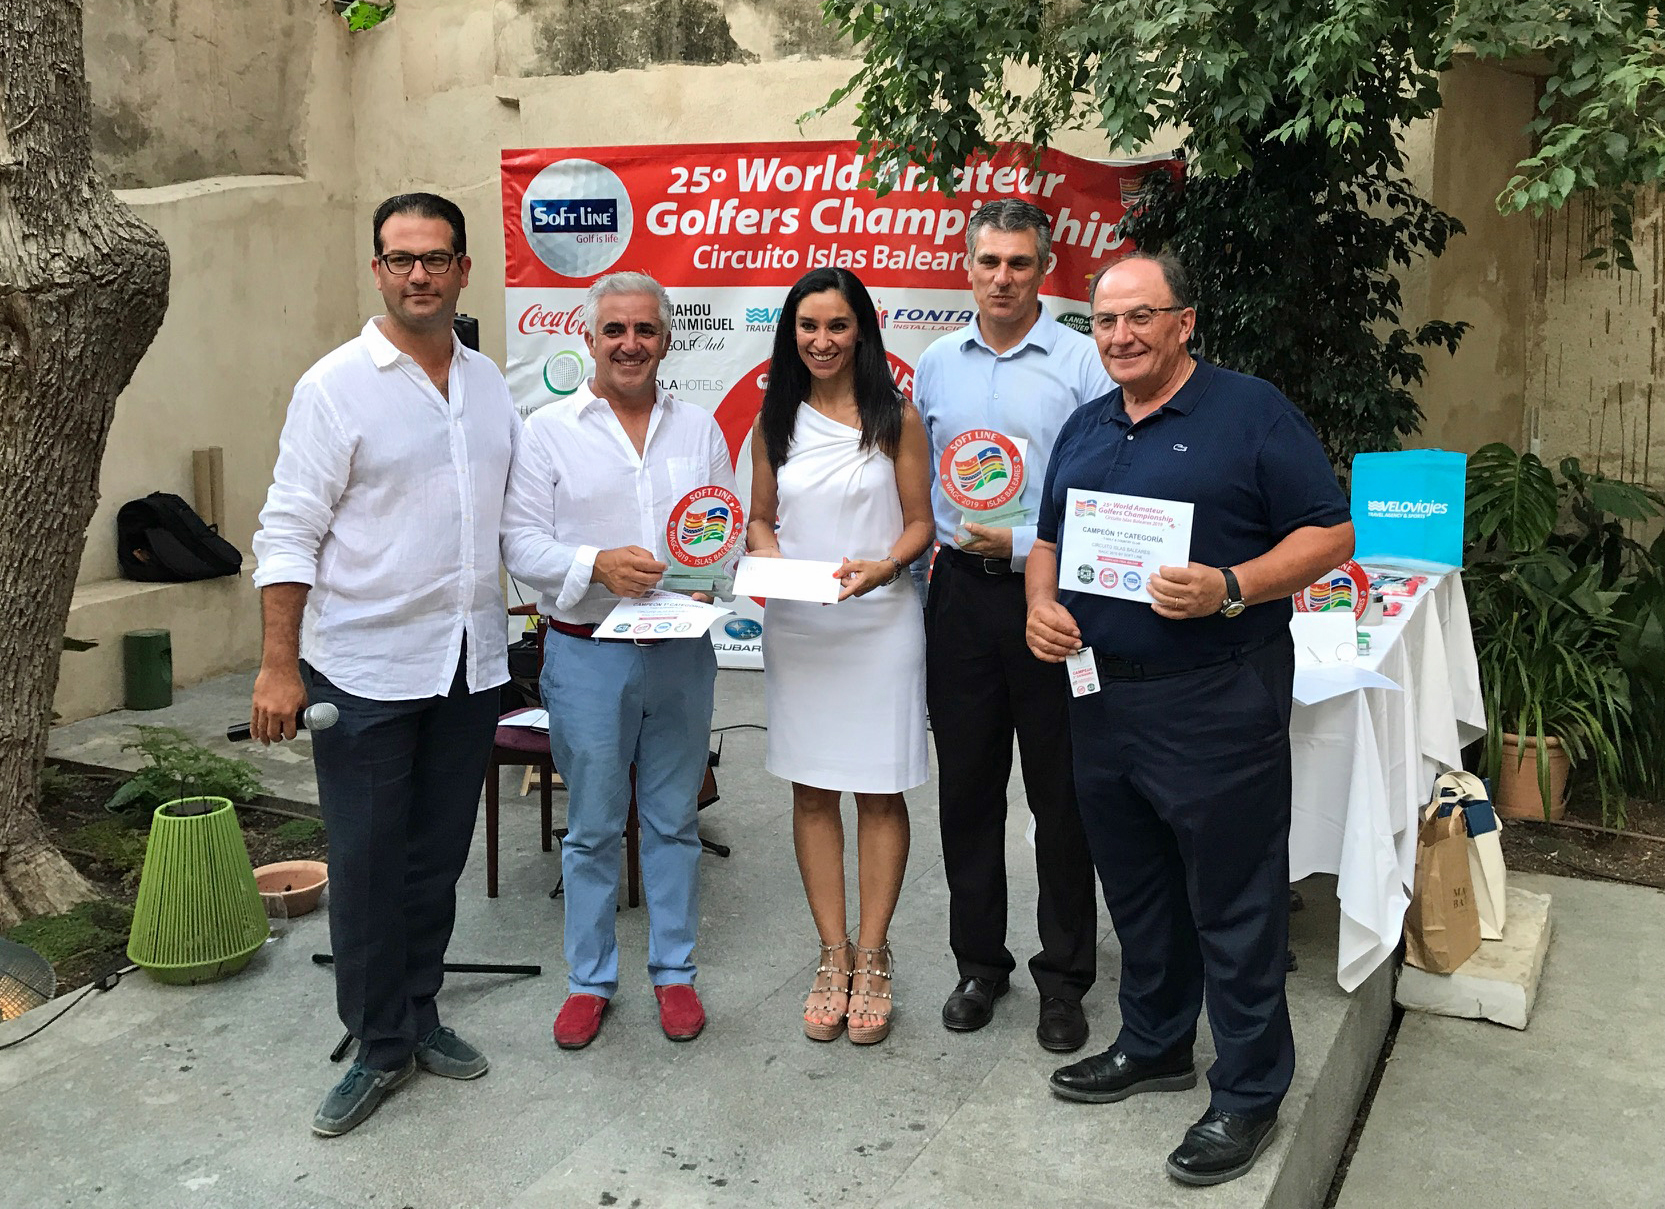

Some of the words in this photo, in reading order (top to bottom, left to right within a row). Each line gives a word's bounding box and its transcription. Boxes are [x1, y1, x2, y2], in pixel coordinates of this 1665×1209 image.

[737, 153, 864, 193] World
[646, 198, 800, 236] Golfers
[810, 197, 1126, 259] Champihip
[576, 235, 595, 243] Golf
[596, 234, 603, 243] is
[604, 234, 619, 243] life
[693, 244, 799, 270] Circuito
[806, 243, 867, 270] Islas
[873, 245, 973, 271] Balear
[671, 318, 734, 331] ANMIGUEL
[950, 432, 972, 452] SOFT
[975, 431, 998, 441] LINE
[946, 481, 963, 501] WAGC
[962, 497, 979, 508] 2019
[986, 493, 1007, 508] ISLAS
[1005, 464, 1021, 497] BALEARES
[689, 488, 712, 502] SOFT
[714, 488, 733, 502] LINE
[1098, 506, 1123, 516] Golfers
[1124, 510, 1174, 524] Championship
[1113, 502, 1134, 511] World
[1134, 505, 1164, 515] Amateur
[675, 549, 689, 562] 2019
[694, 557, 713, 565] ISLAS
[714, 643, 763, 652] SUBAR
